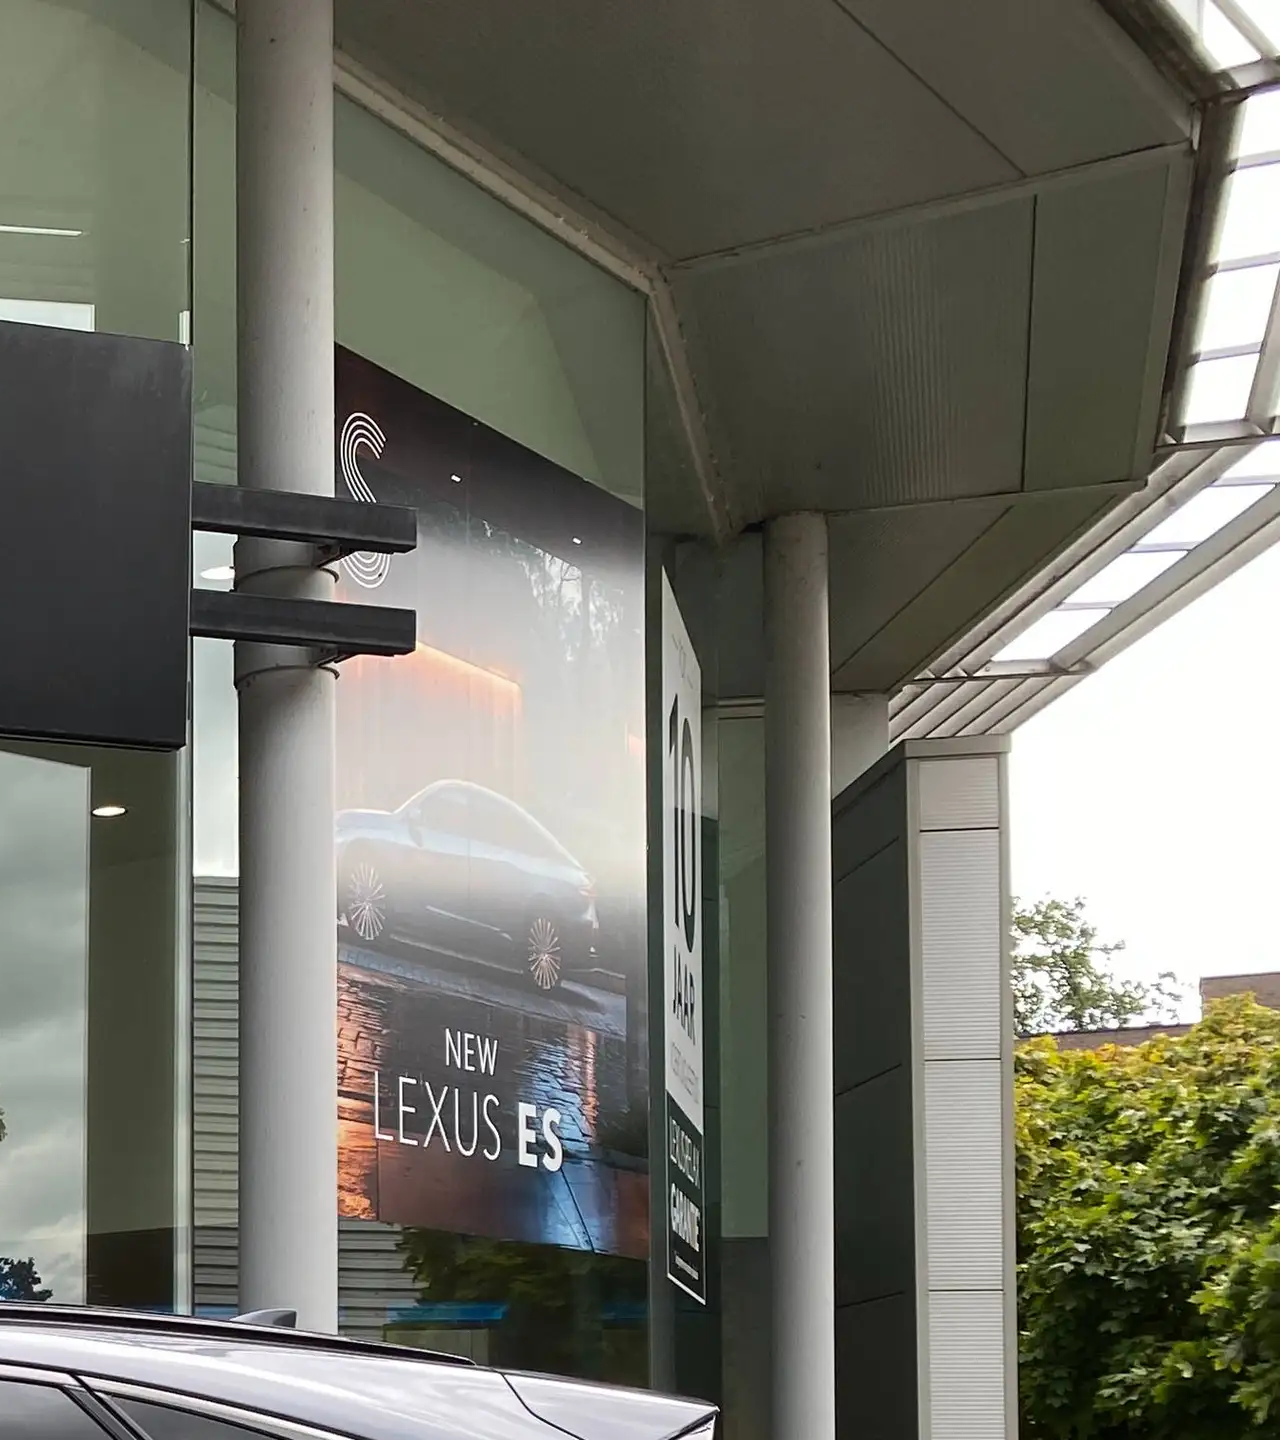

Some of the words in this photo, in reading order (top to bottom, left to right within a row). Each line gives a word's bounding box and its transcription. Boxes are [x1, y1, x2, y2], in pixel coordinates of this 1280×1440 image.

[668, 692, 697, 954] 10
[672, 944, 697, 1046] JAAR
[445, 1028, 499, 1076] NEW
[374, 1069, 502, 1162] LEXUS
[518, 1101, 564, 1173] ES
